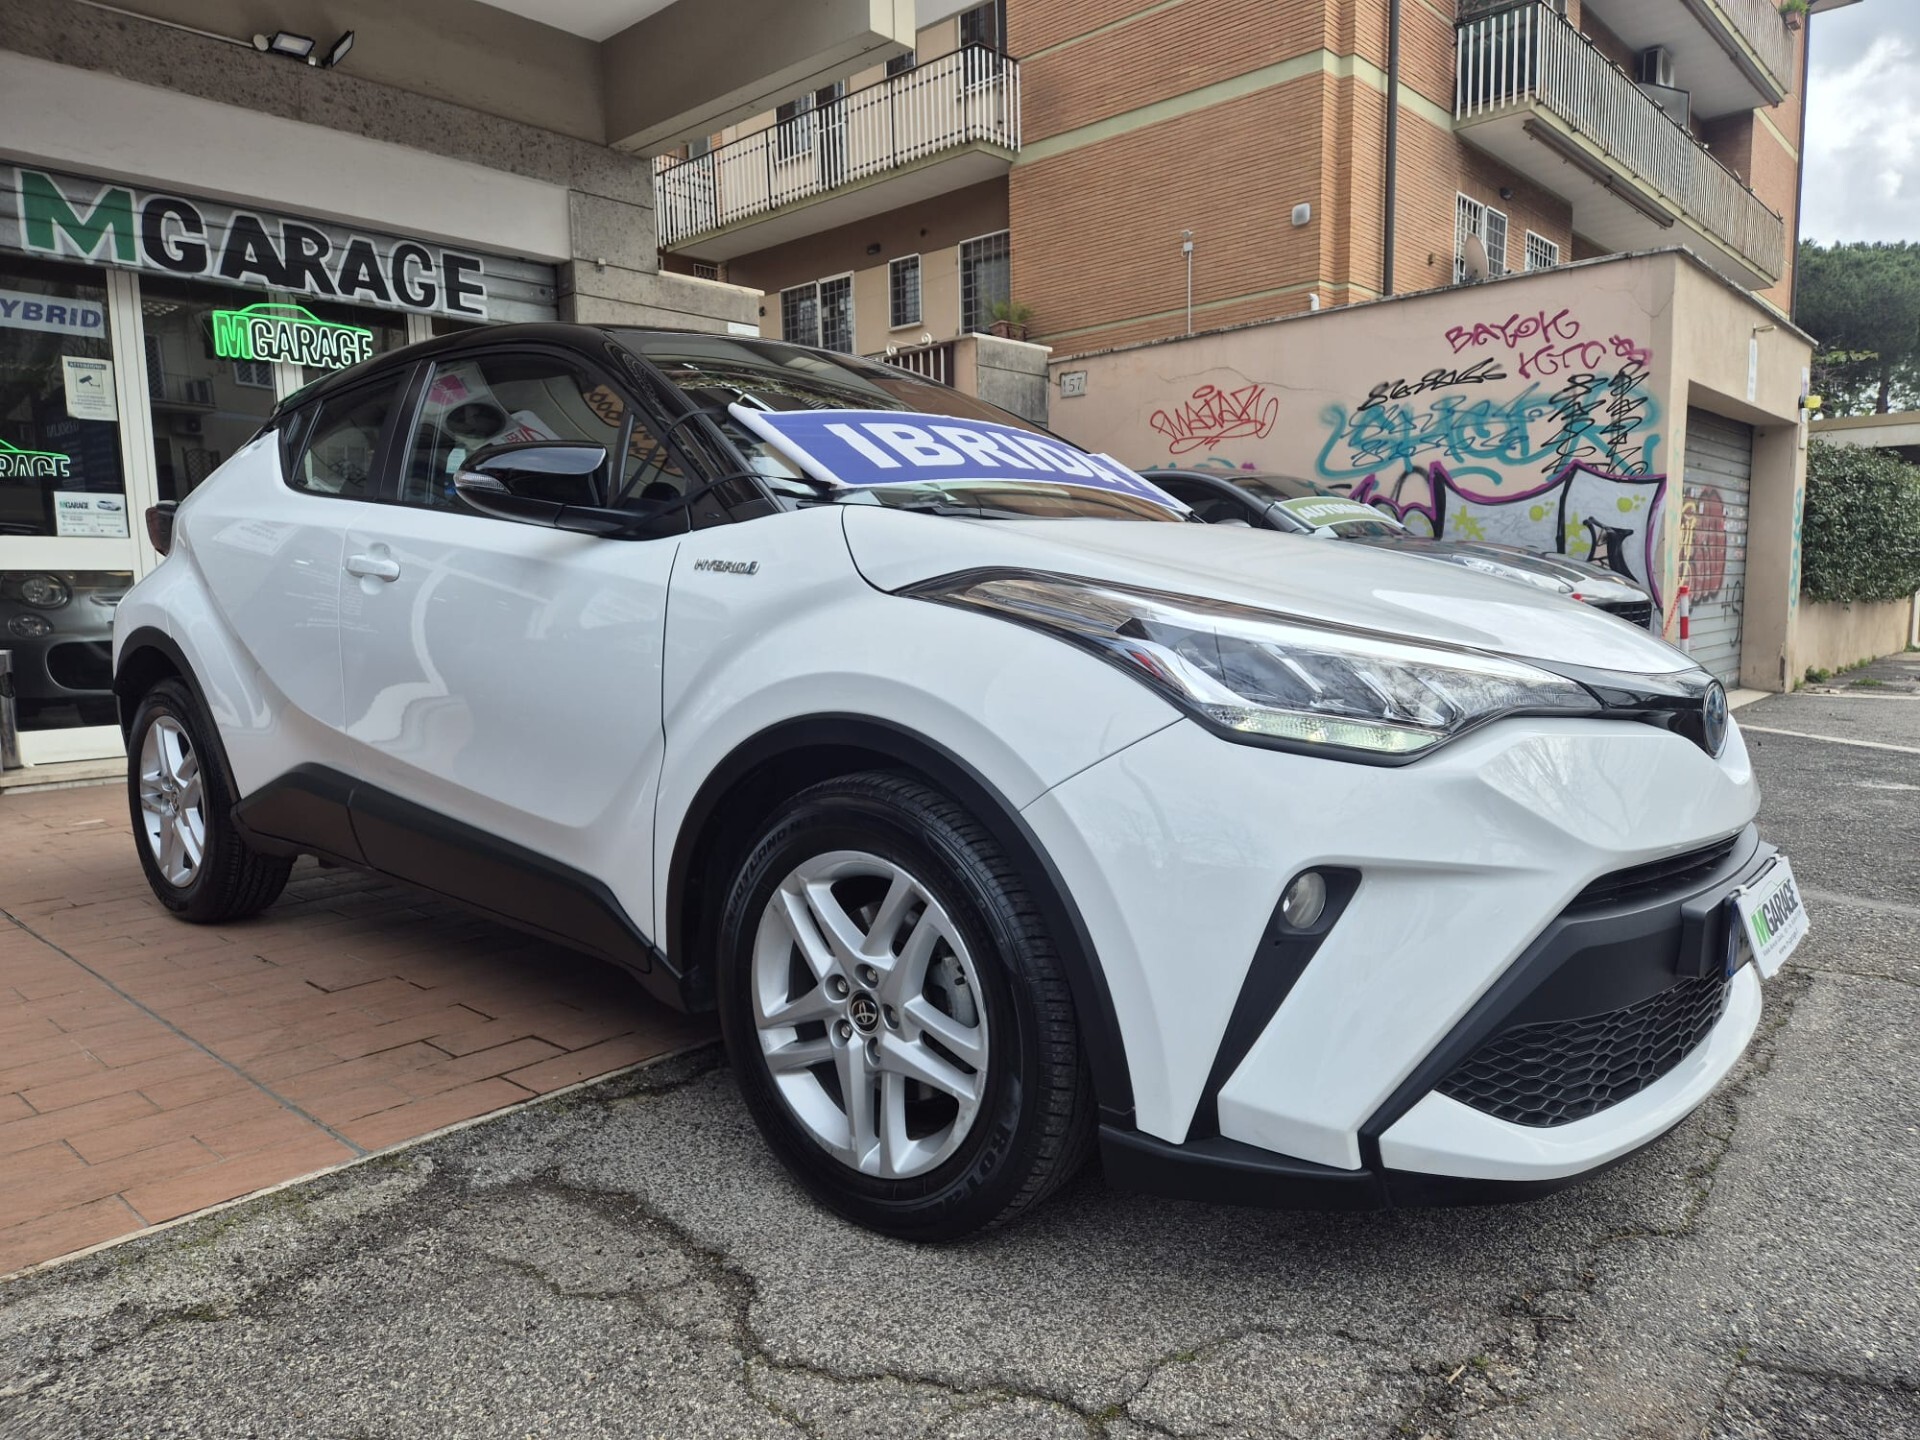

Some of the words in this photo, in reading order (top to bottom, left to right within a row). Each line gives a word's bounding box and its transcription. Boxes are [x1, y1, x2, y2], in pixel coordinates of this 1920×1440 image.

[14, 168, 488, 320] MGARAGE
[212, 313, 373, 369] MGARAGE
[823, 423, 1143, 491] IBRIDA
[1751, 879, 1799, 947] MGARAGE
